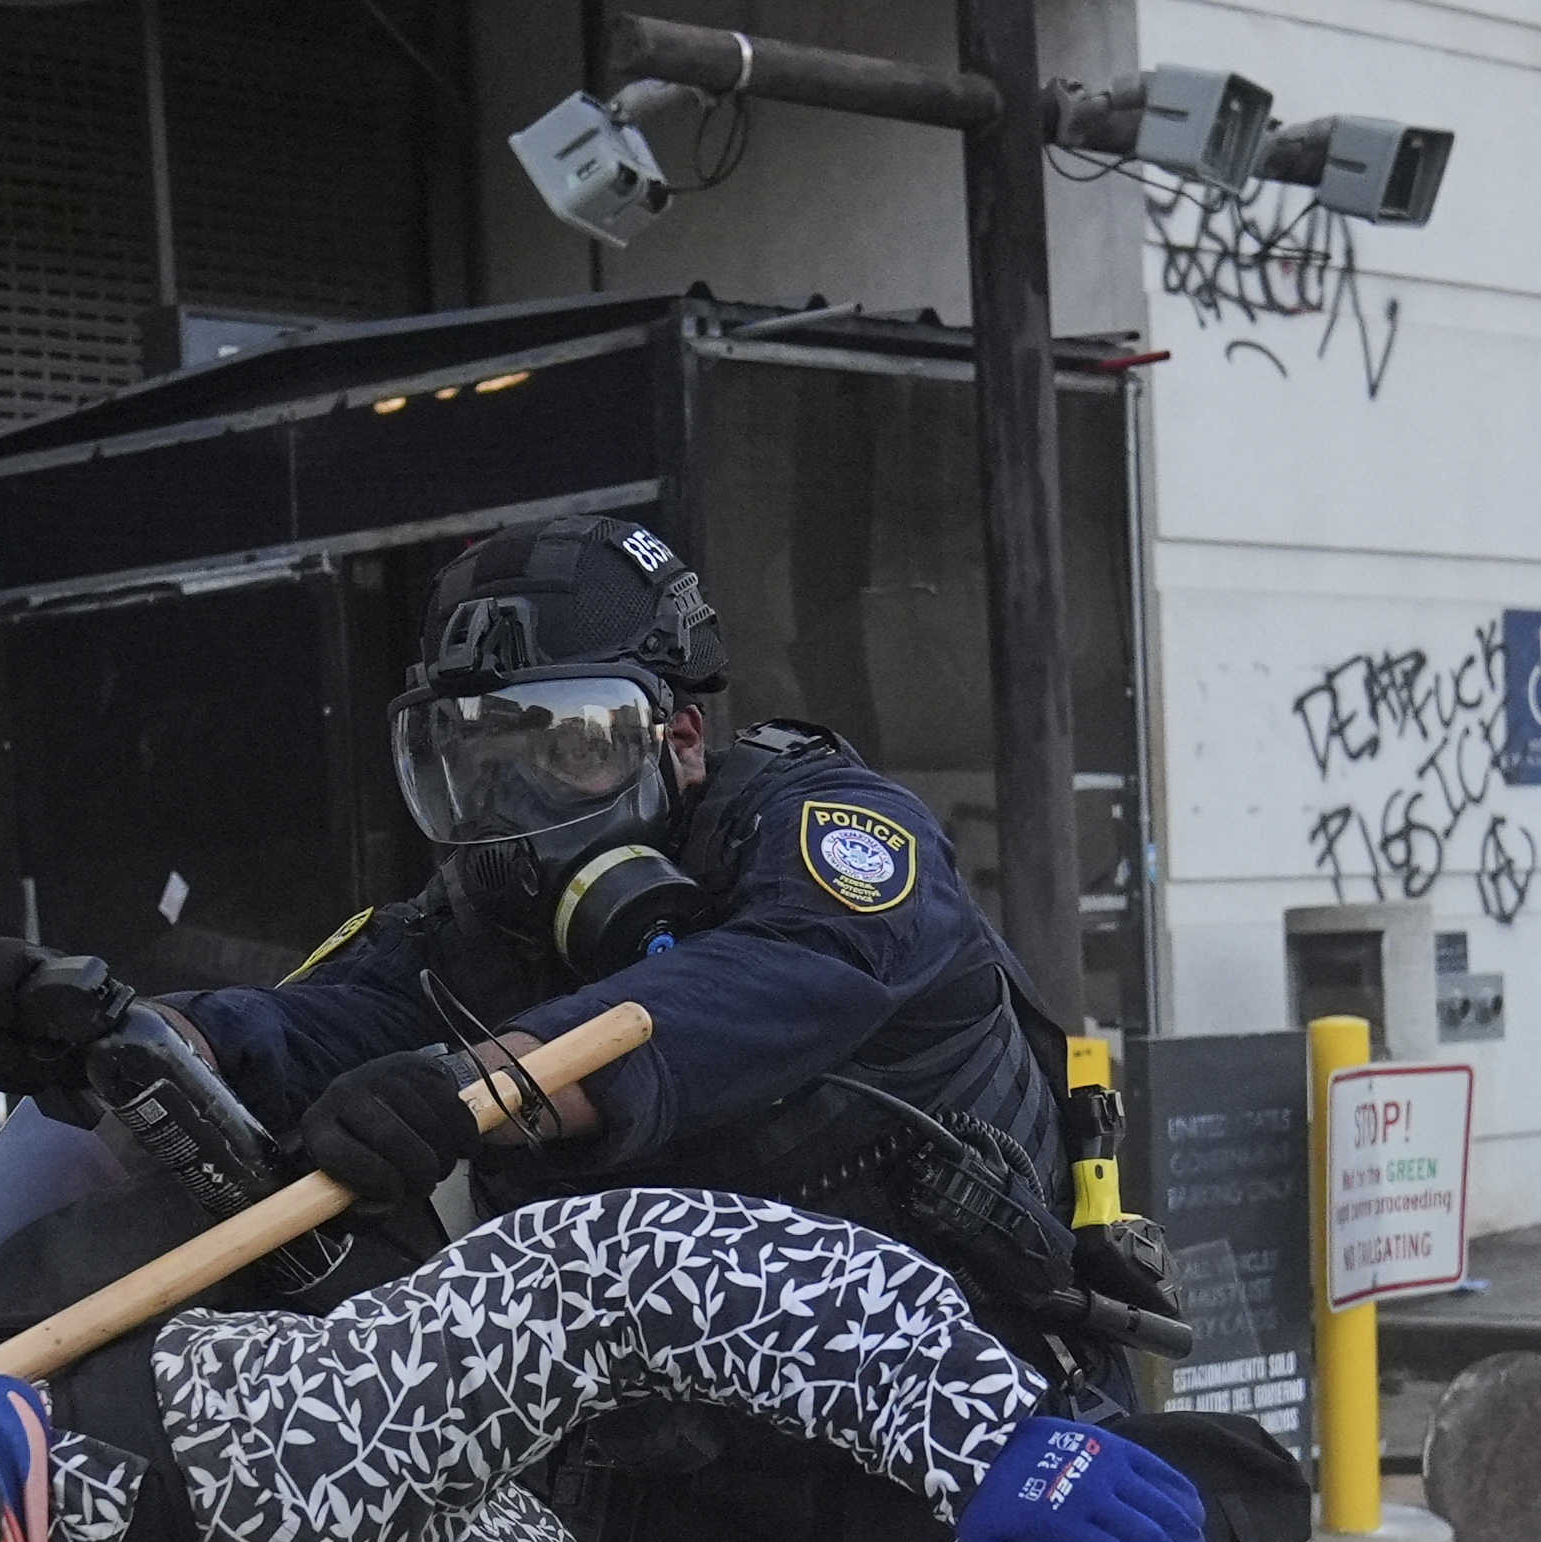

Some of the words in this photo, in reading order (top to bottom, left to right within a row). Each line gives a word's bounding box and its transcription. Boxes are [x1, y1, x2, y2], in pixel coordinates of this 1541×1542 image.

[813, 810, 906, 852] POLICE
[1308, 788, 1443, 904] PIGS
[1352, 1099, 1413, 1149] STOP!
[1385, 1156, 1438, 1184] GREEN
[1374, 1187, 1453, 1216] proceeding
[1268, 1350, 1297, 1379] SOLO
